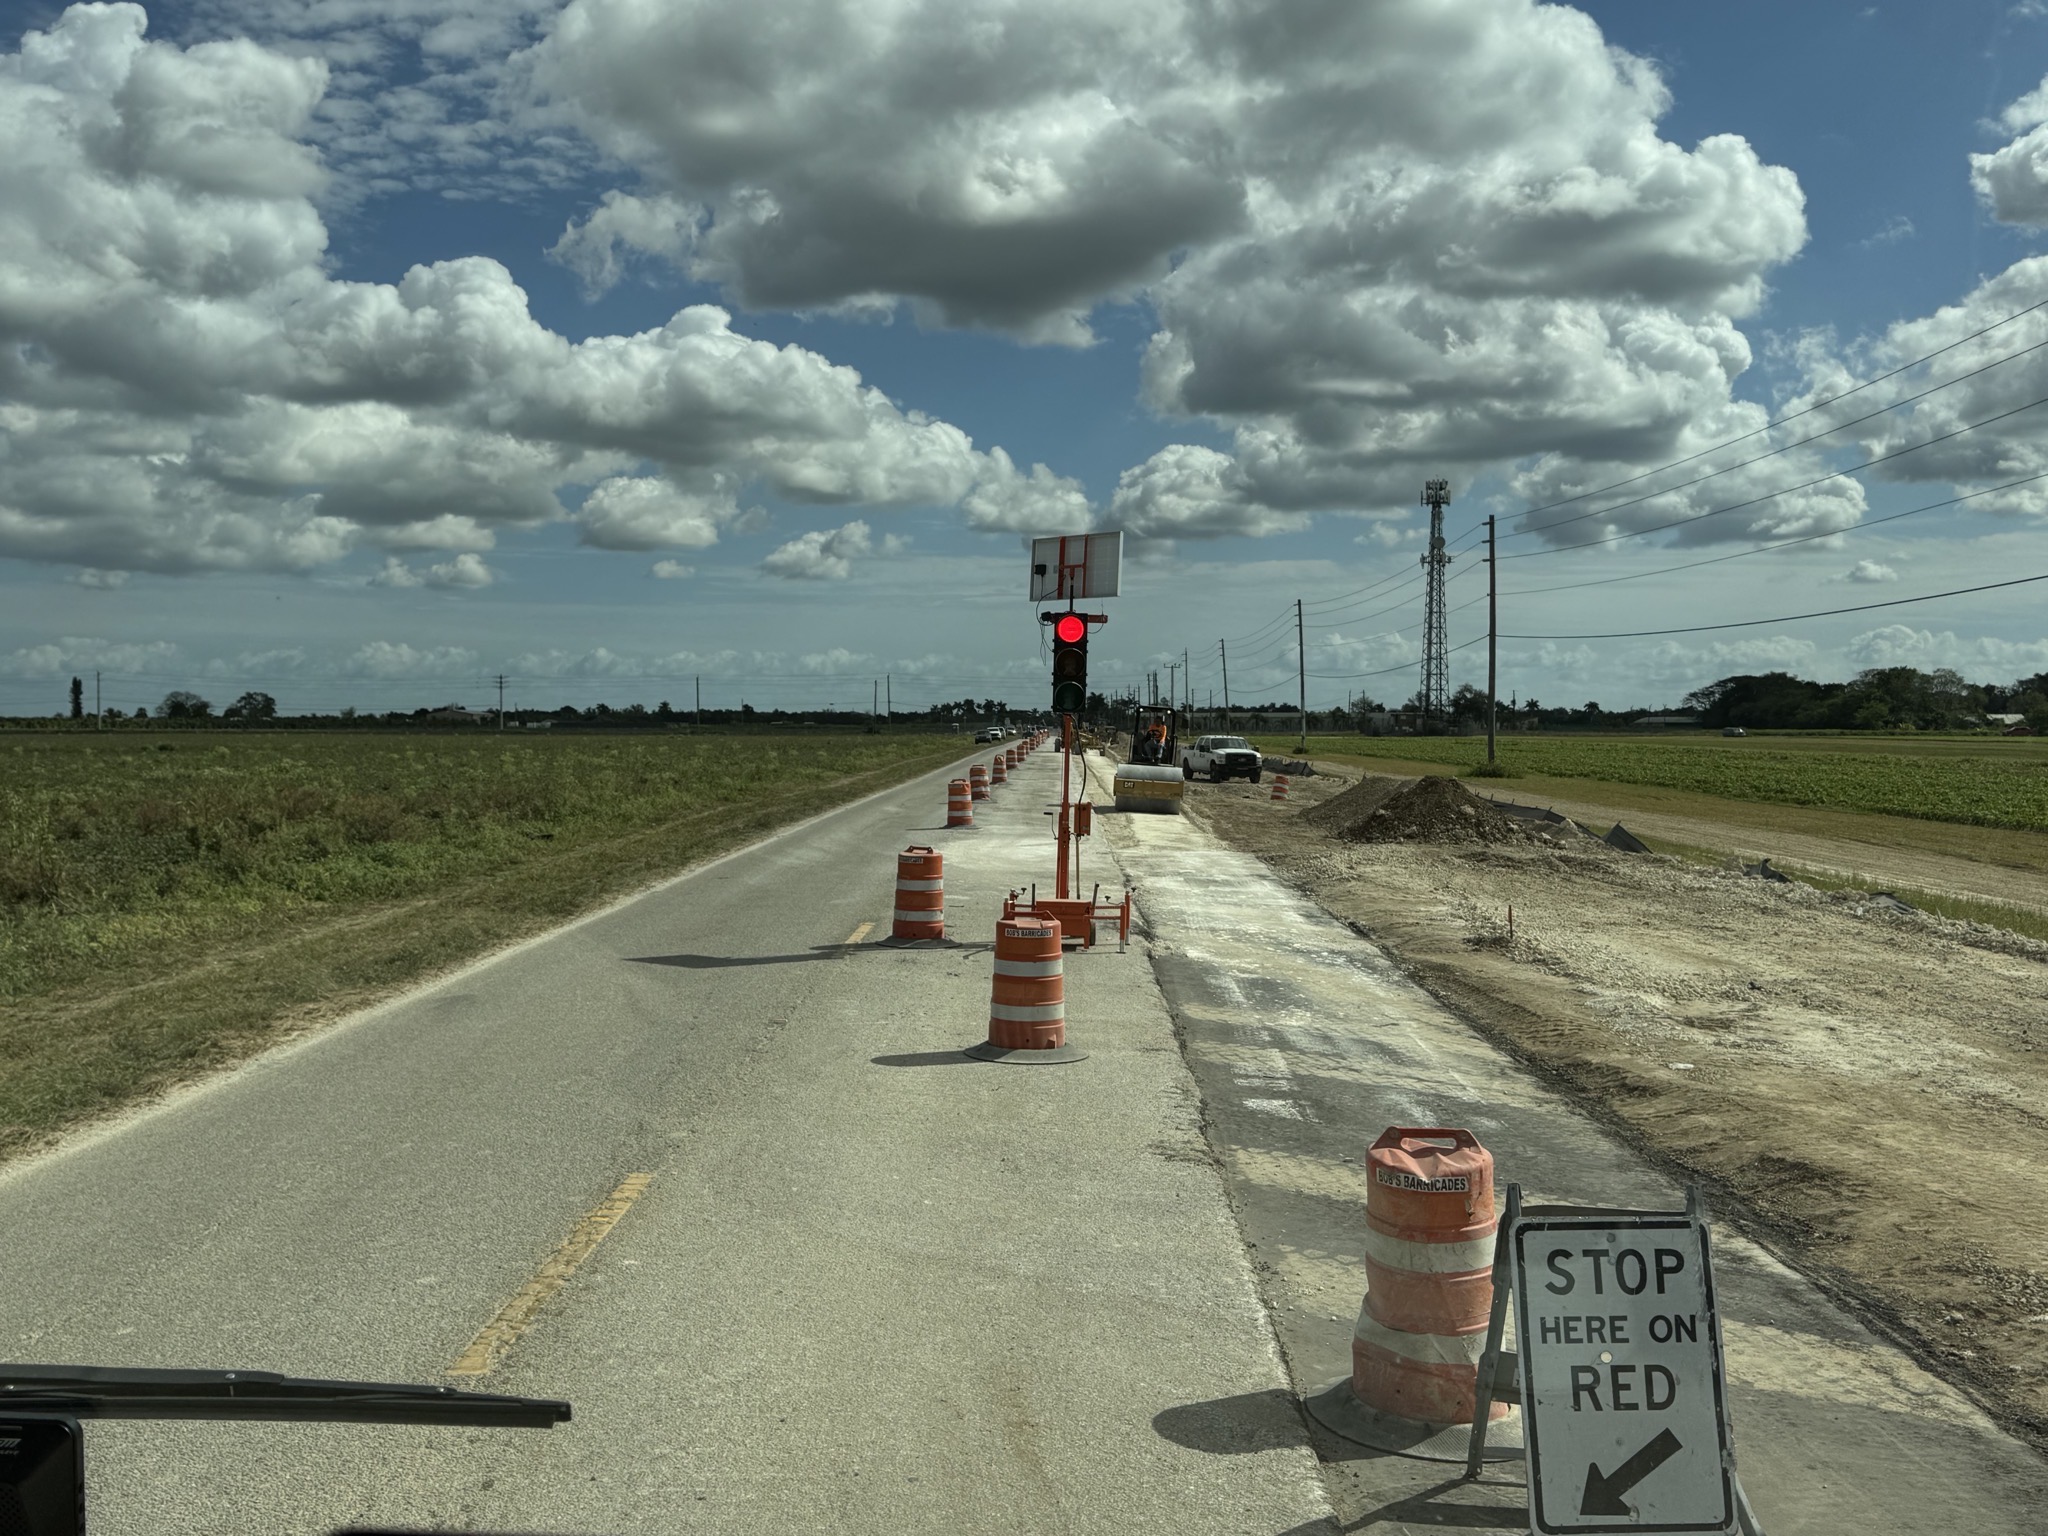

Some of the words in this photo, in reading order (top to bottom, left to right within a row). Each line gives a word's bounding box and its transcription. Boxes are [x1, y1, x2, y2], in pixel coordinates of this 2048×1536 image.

[1379, 1170, 1401, 1187] BOB'S
[1403, 1175, 1466, 1192] BARRICADES
[1544, 1248, 1685, 1296] STOP
[1539, 1315, 1630, 1345] HERE
[1648, 1314, 1698, 1344] ON
[1570, 1364, 1676, 1412] RED
